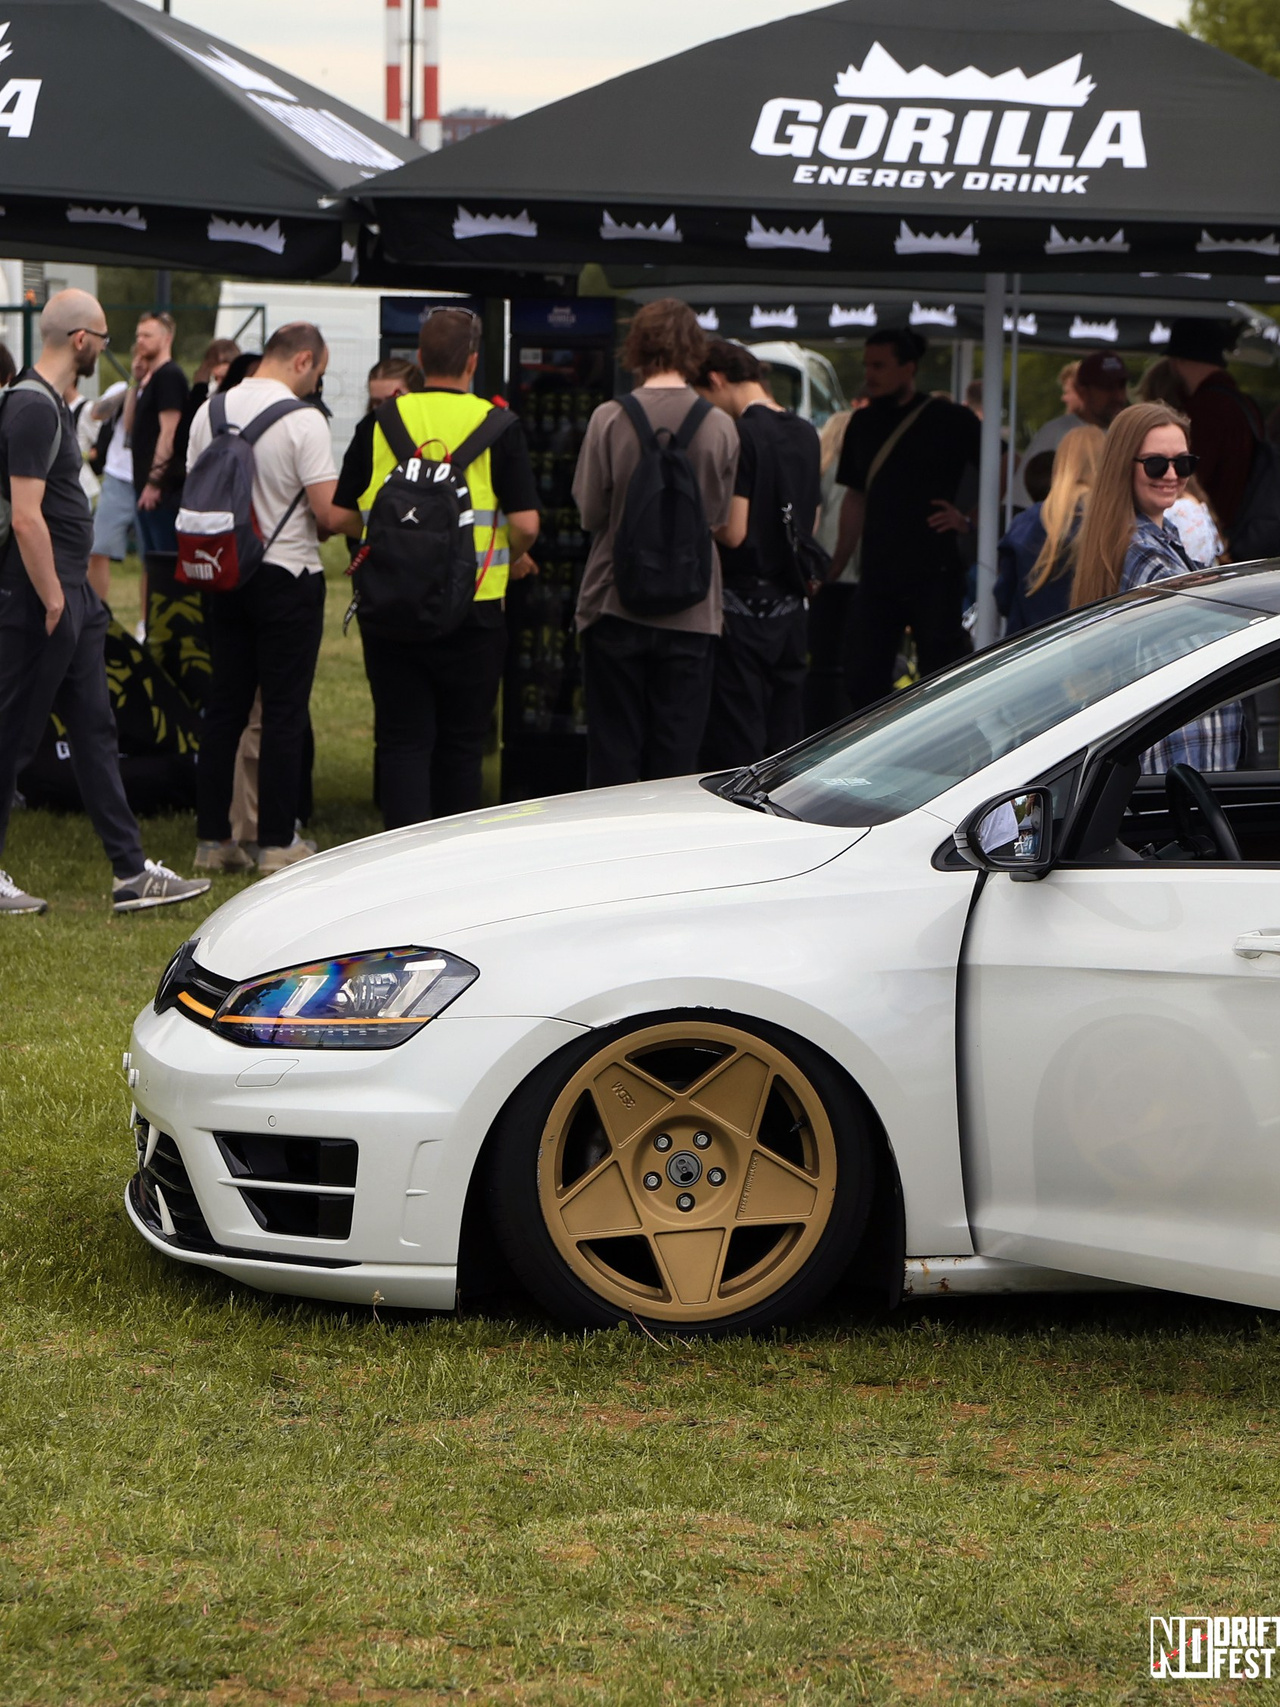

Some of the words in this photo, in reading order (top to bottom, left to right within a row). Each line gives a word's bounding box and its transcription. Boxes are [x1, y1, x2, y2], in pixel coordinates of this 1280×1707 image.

[750, 97, 1148, 168] GORILLA
[793, 165, 955, 190] ENERGY
[961, 171, 1089, 194] DRINK
